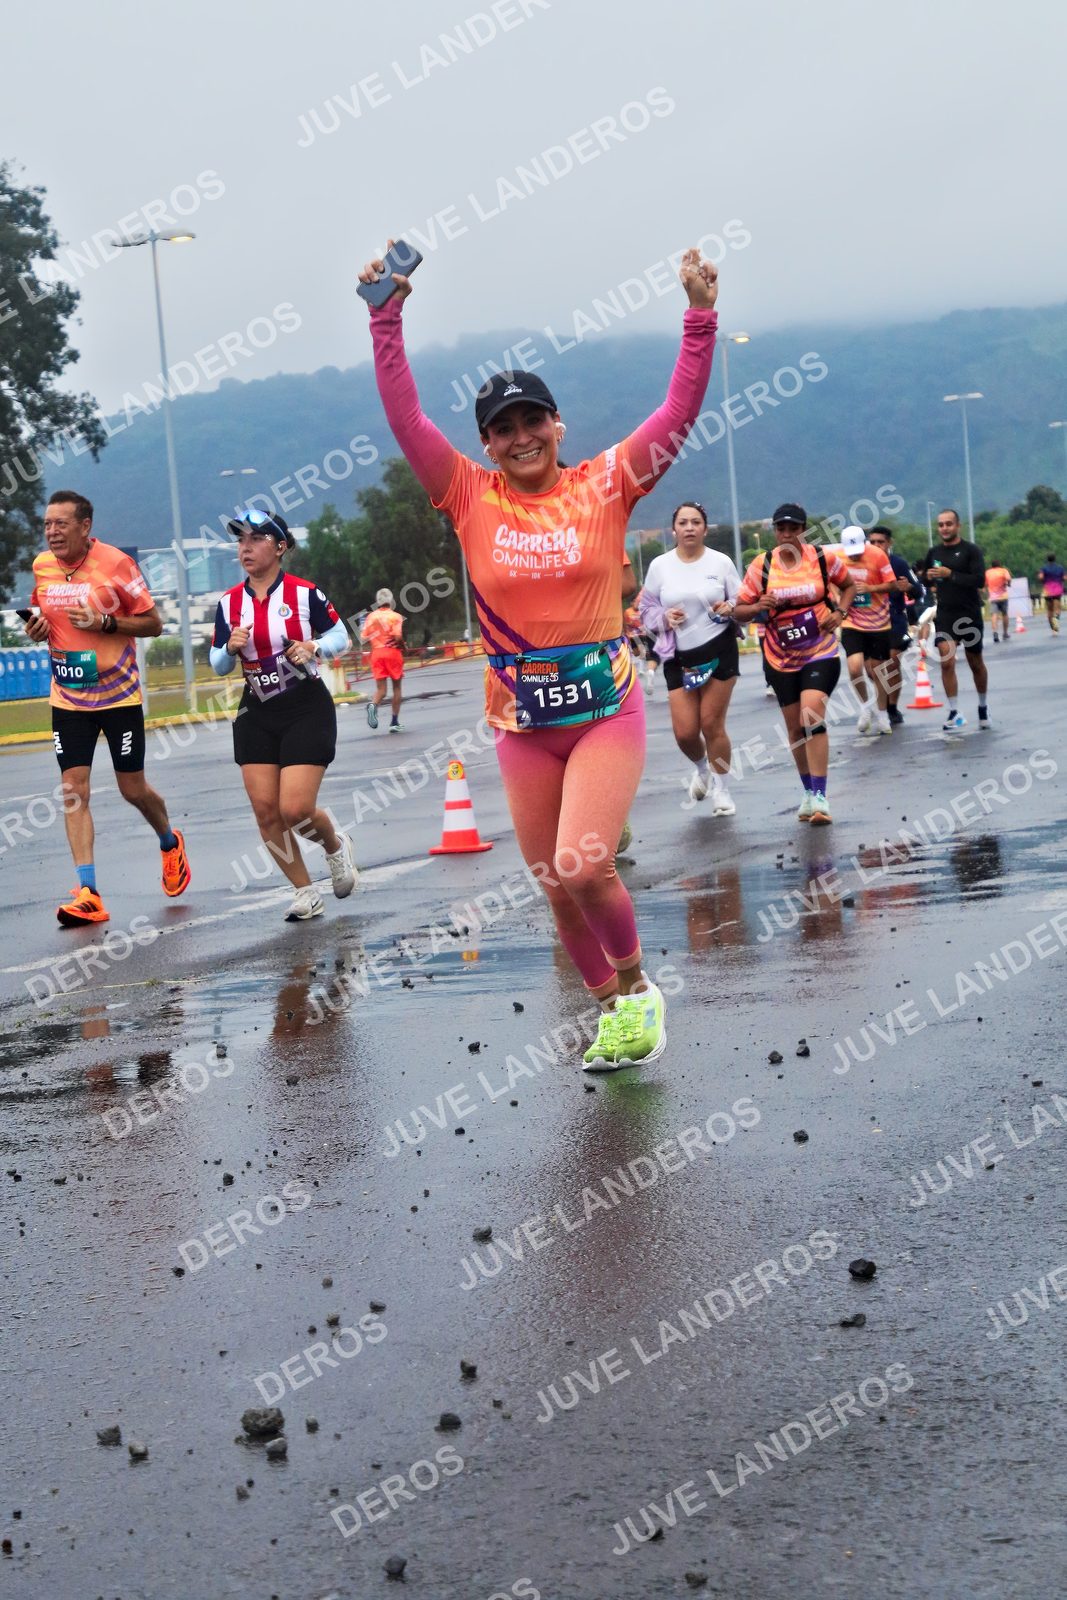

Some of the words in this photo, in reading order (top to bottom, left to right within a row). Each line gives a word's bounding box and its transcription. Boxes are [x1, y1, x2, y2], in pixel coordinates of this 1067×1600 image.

[495, 524, 580, 553] CARRERA
[493, 549, 562, 569] OMNILIFE
[787, 626, 807, 640] 531
[584, 650, 601, 667] 10K
[56, 664, 84, 678] 1010
[521, 662, 558, 674] CARRERA
[253, 671, 280, 687] 196
[521, 675, 549, 683] OMNILIFE
[534, 679, 593, 708] 1531
